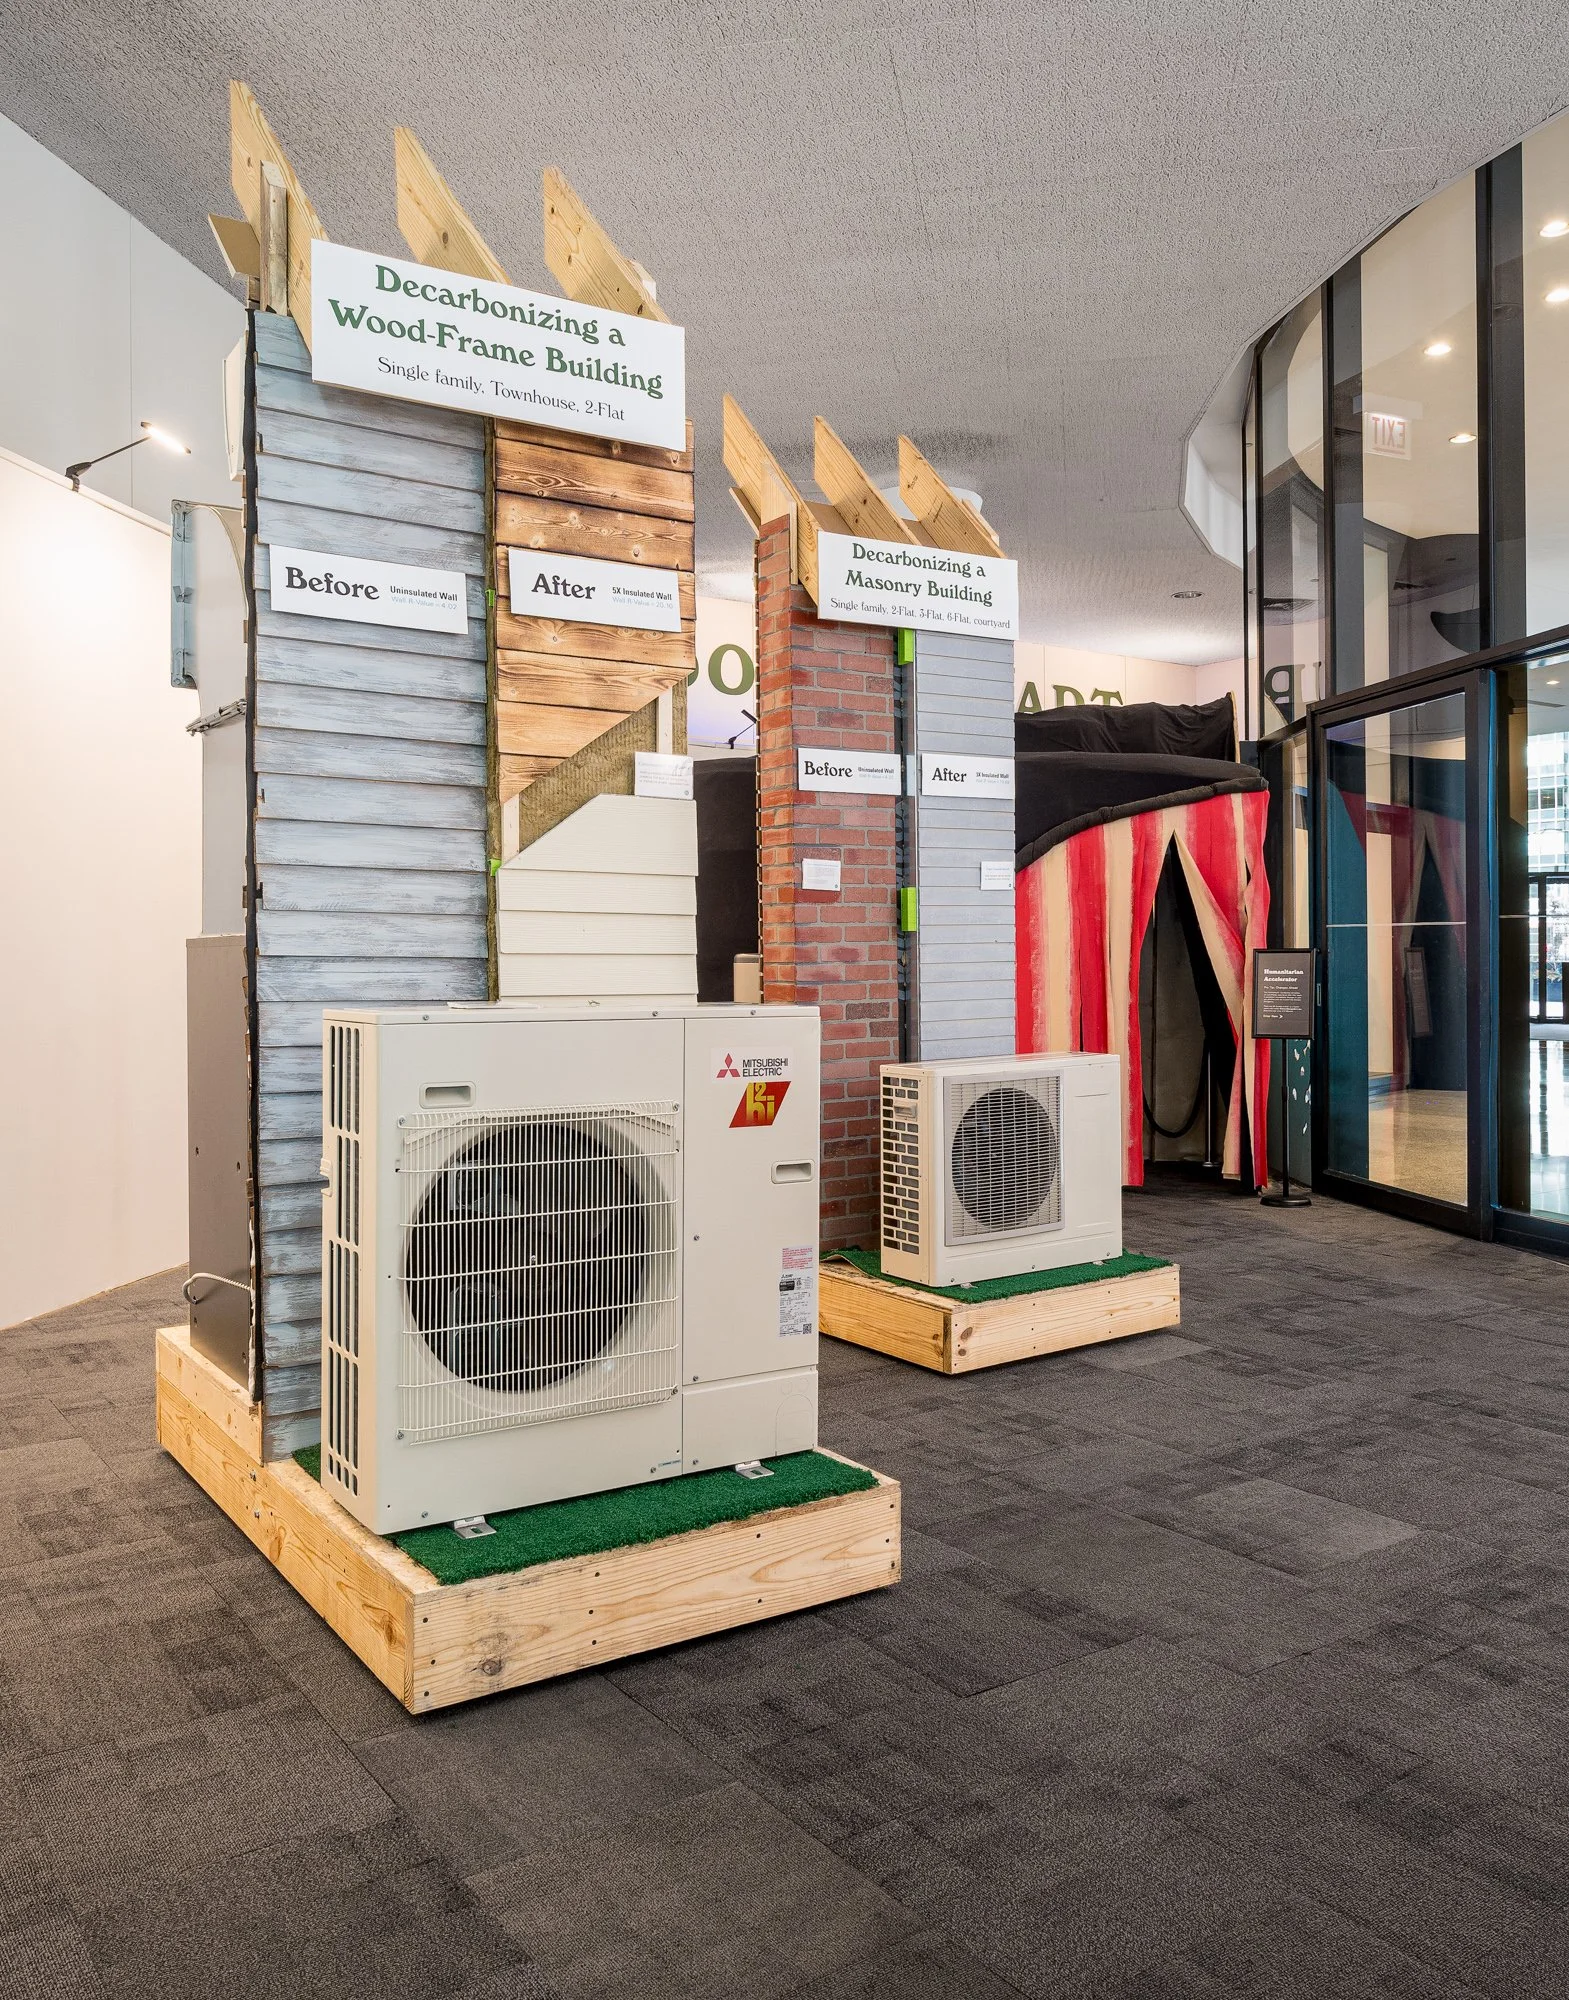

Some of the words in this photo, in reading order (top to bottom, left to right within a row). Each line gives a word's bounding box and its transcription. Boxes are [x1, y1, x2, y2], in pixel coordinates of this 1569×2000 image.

[375, 264, 600, 345] Decarbonizing
[608, 328, 626, 346] a
[328, 298, 536, 368] Wood-Frame
[545, 346, 664, 400] Building
[377, 356, 430, 382] Single
[435, 369, 485, 395] family,
[490, 380, 580, 413] Townhouse,
[584, 400, 625, 421] 2-Flat
[852, 542, 972, 578] Decarbonizing
[976, 566, 986, 577] a
[286, 566, 380, 600] Before
[390, 585, 438, 599] Uninsulated
[438, 591, 458, 602] Wall
[532, 572, 596, 600] After
[612, 586, 622, 595] 5X
[622, 587, 655, 599] Insulated
[655, 591, 672, 601] Wall
[845, 569, 922, 598] Masonry
[927, 580, 993, 607] Building
[830, 597, 859, 612] Single
[861, 602, 890, 616] family,
[973, 617, 1011, 630] courtyard
[804, 760, 854, 778] Before
[932, 767, 968, 783] After
[742, 1057, 789, 1068] MITSUBISHI
[742, 1067, 782, 1077] ELECTRIC
